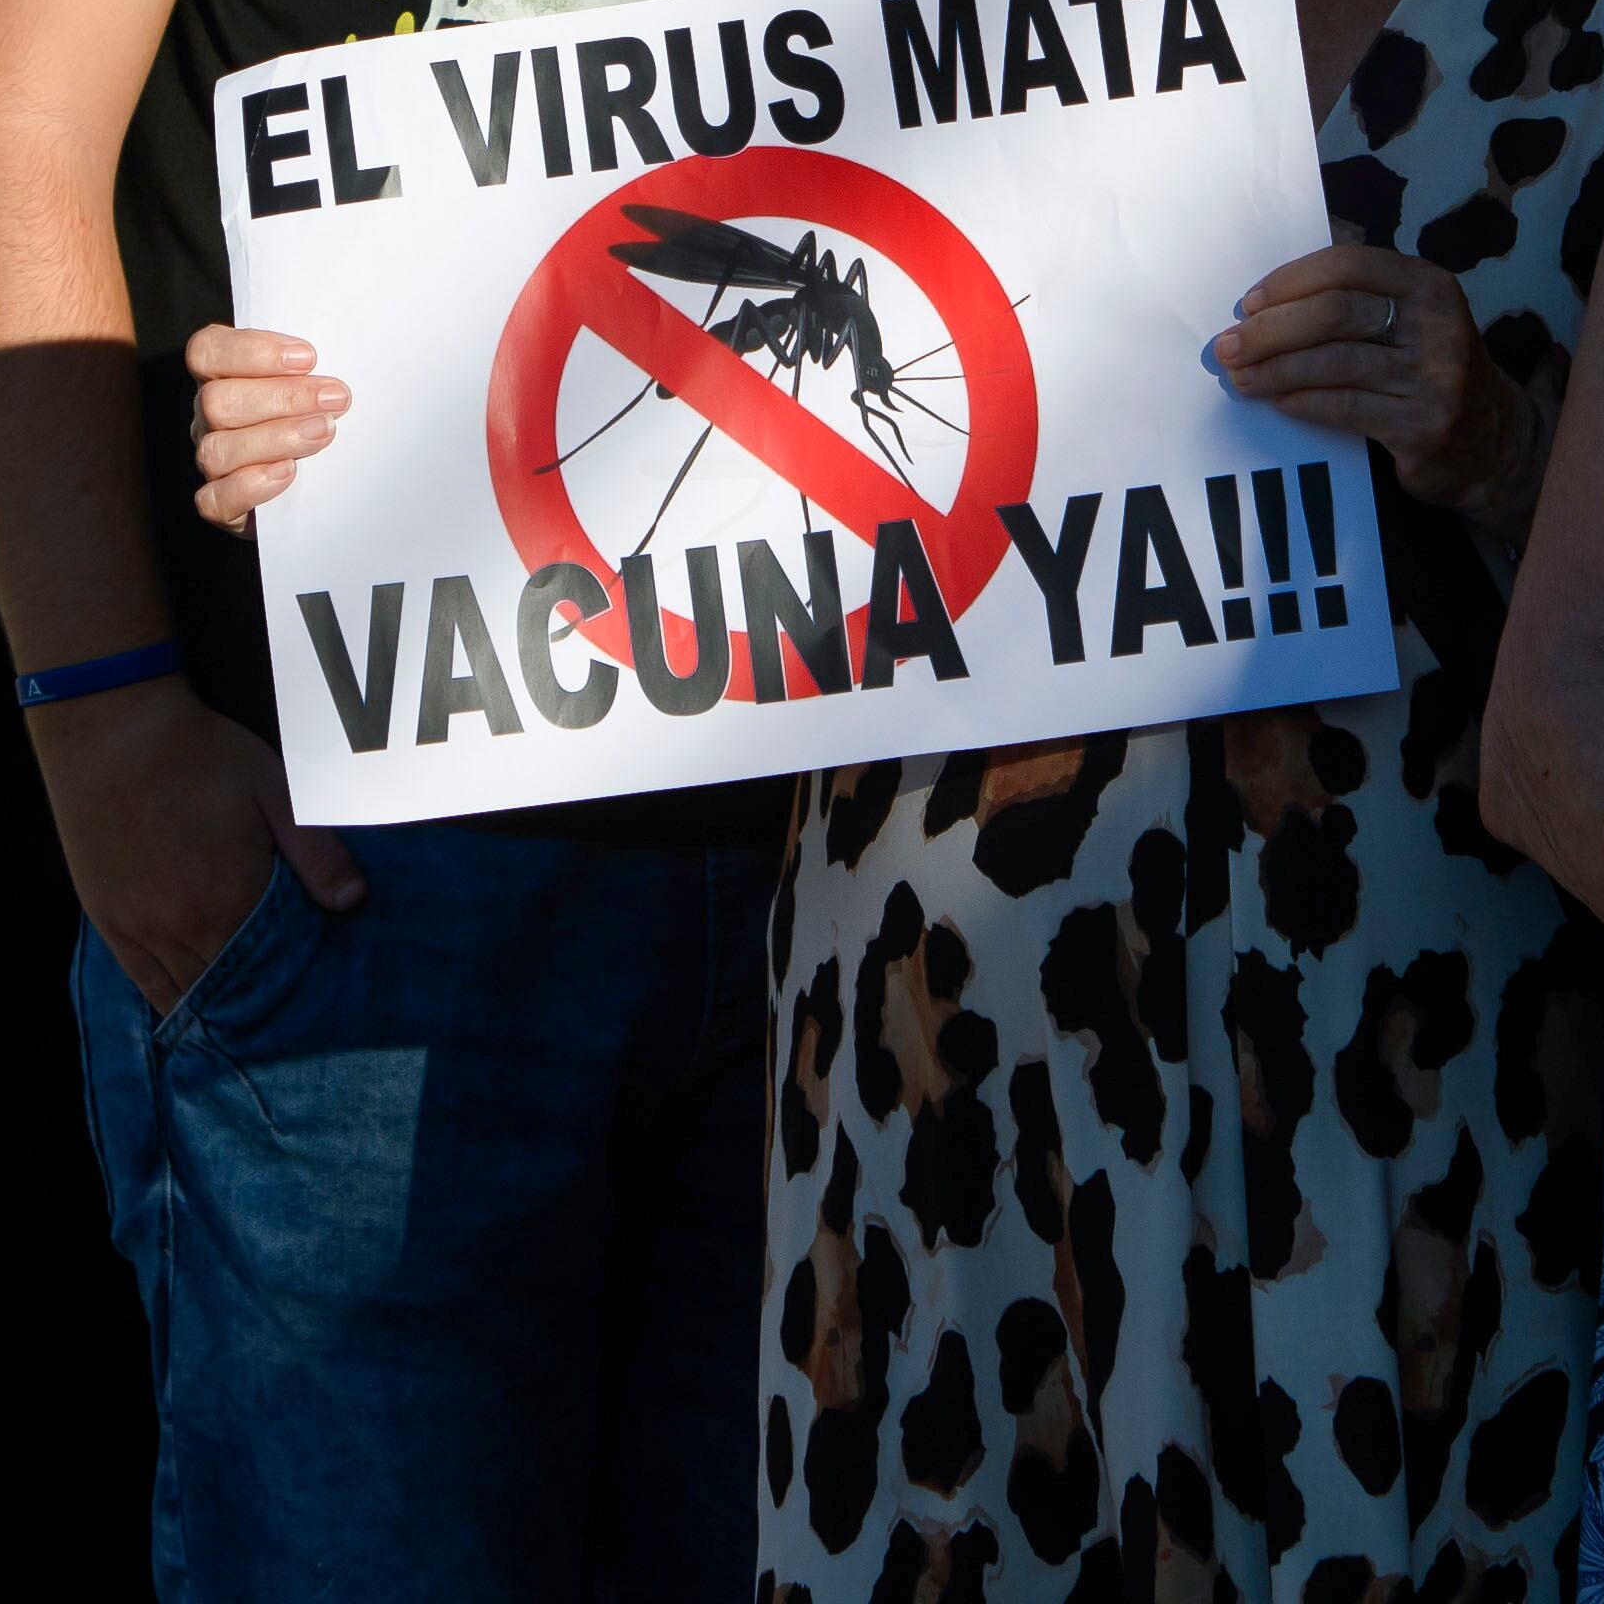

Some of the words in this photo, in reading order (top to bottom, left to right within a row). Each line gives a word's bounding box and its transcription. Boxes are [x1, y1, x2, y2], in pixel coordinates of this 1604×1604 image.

[242, 76, 403, 219] EL
[430, 9, 845, 188] VIRUS
[296, 517, 970, 754] VACUNA
[996, 460, 1352, 666] YA!!!
